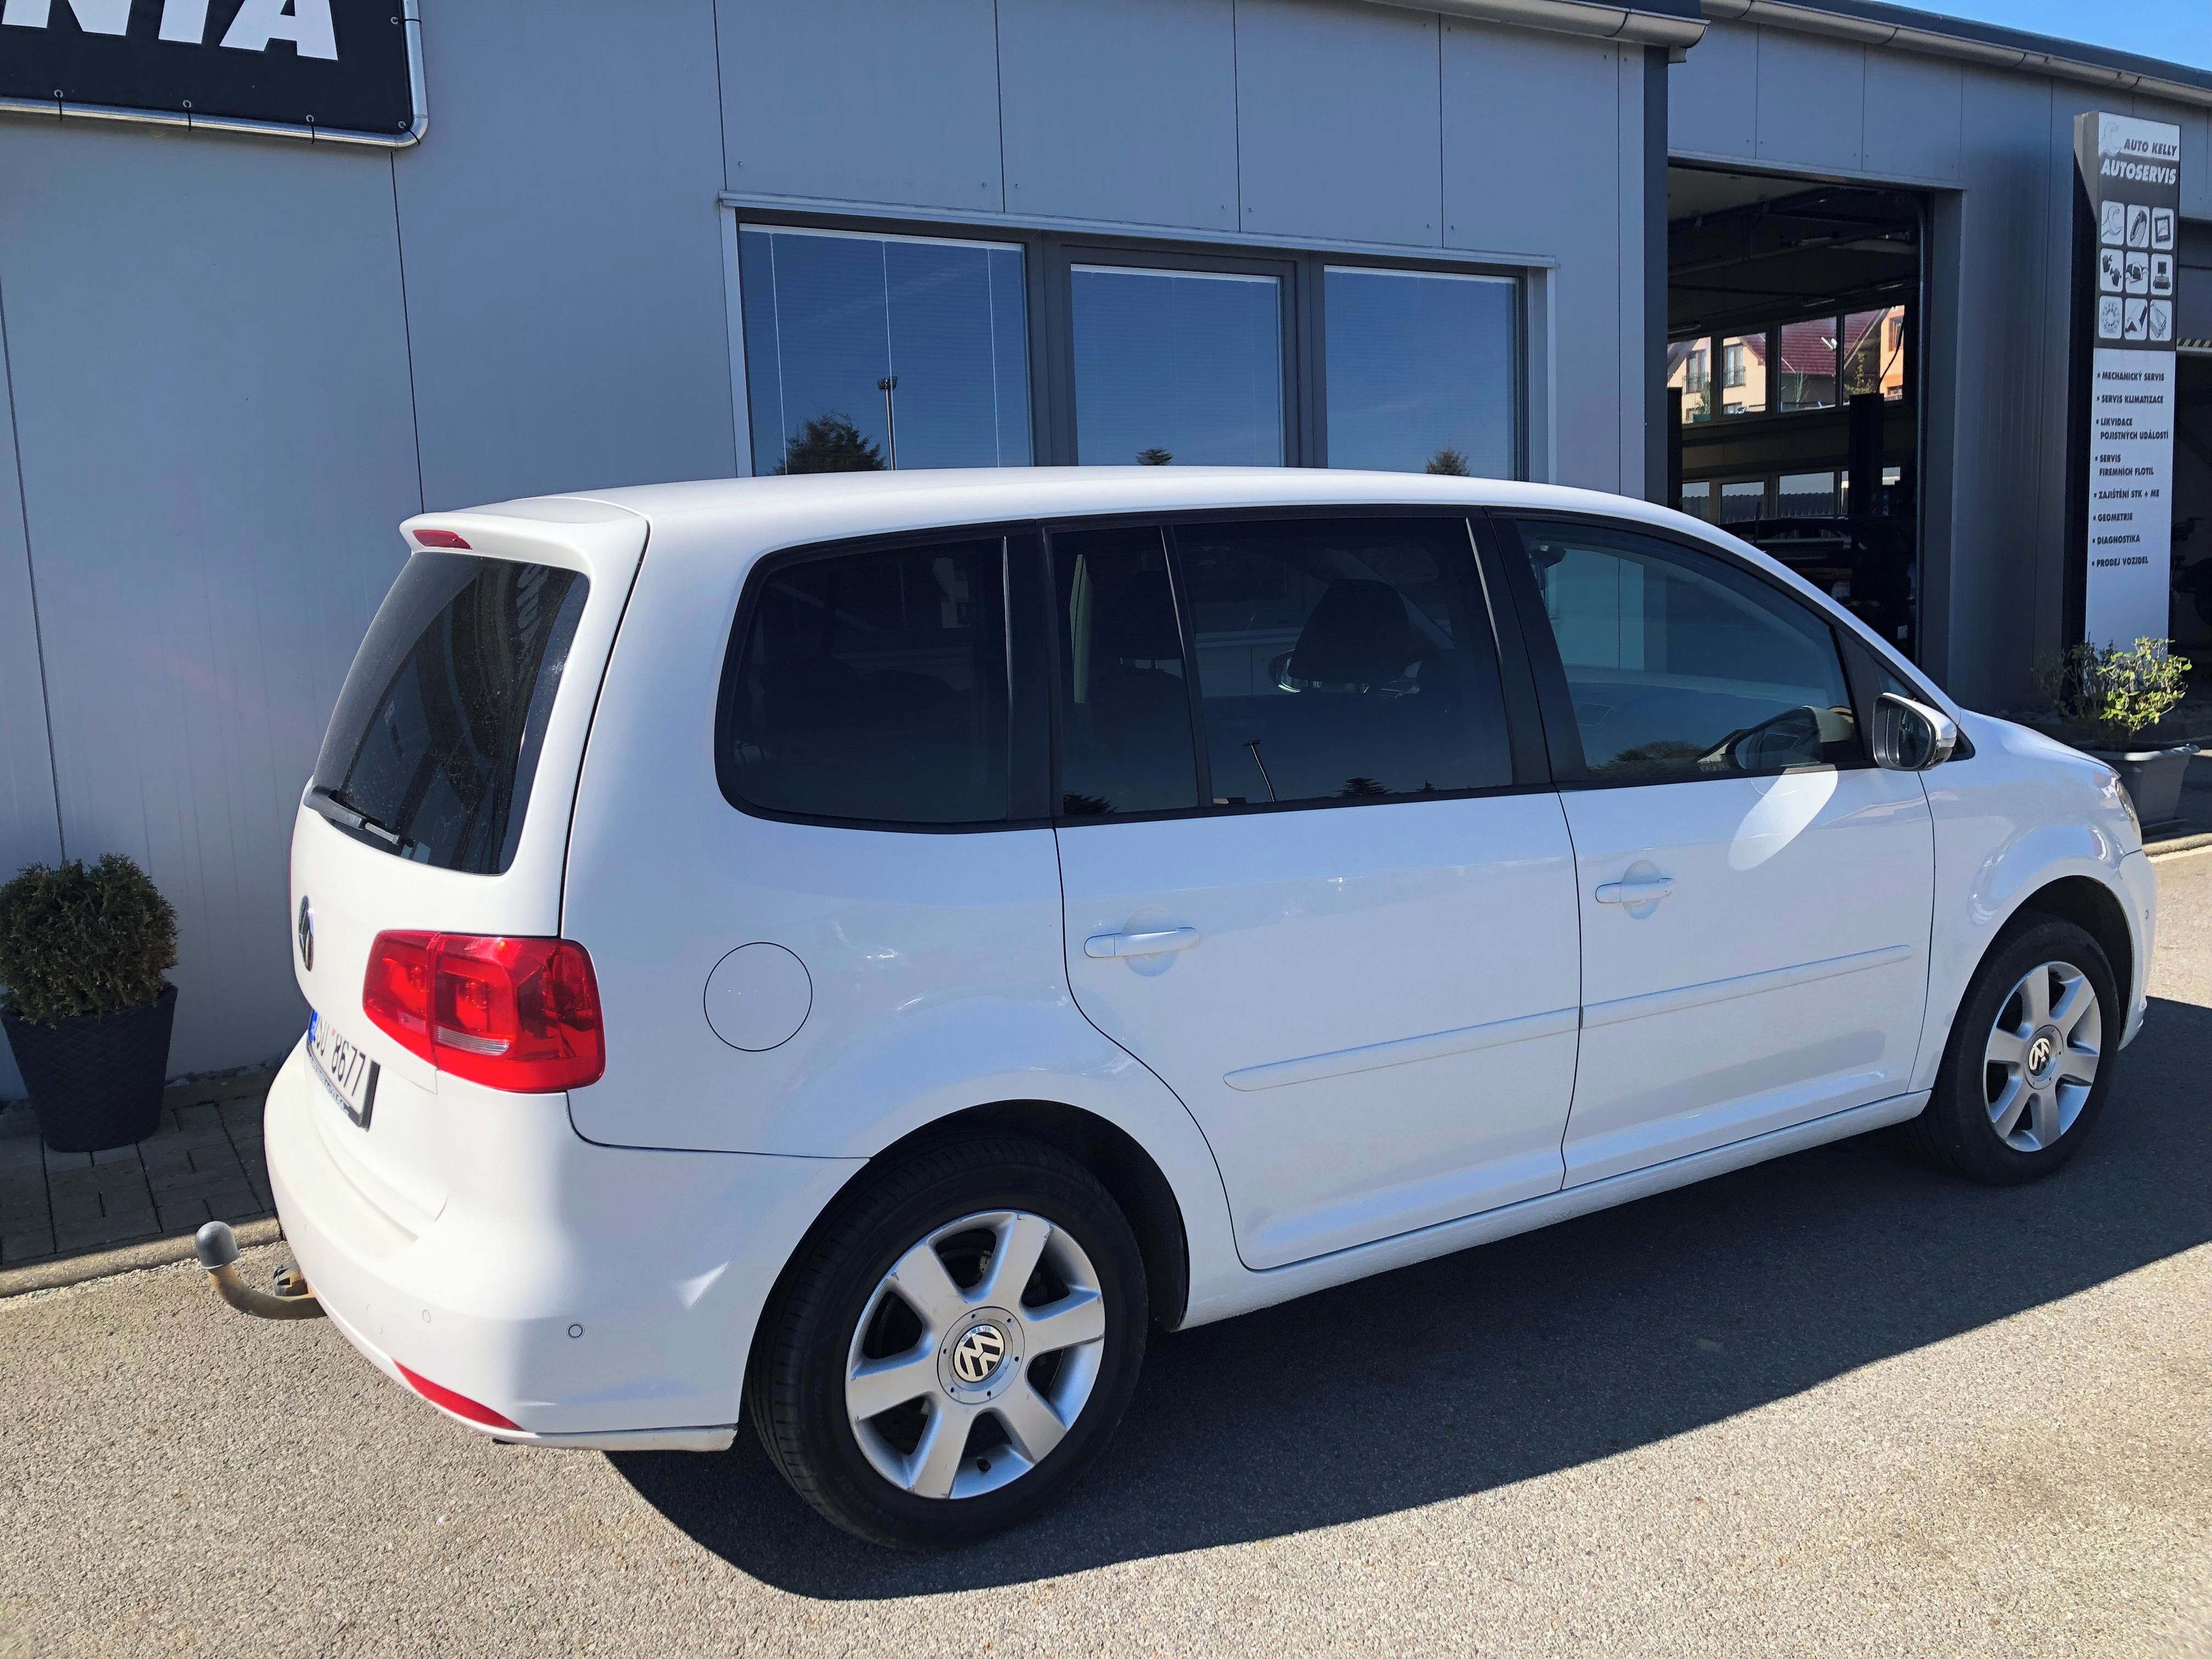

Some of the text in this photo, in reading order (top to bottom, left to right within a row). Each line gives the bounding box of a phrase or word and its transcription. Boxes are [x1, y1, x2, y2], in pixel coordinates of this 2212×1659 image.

[2124, 138, 2177, 156] AUTO KELLY
[2101, 159, 2176, 184] AUTOSERVIS
[2102, 371, 2164, 381] MECHANICKÝ SERVIS
[2101, 394, 2164, 404] SERVIS KLIMATIZACE
[2101, 417, 2132, 426] LIKVIDACE
[2100, 429, 2169, 439] POJISTNÝCH UDÁLOSTÍ
[2100, 454, 2121, 462] SERVIS
[2099, 466, 2154, 476] FIREMNÍCH FLOTIL
[2131, 490, 2142, 498] STK
[2151, 489, 2159, 497] ME
[2097, 512, 2133, 522] GEOMETRIE
[2097, 534, 2140, 545] DIAGNOSTIKA
[2096, 556, 2148, 567] PRODEJ VOZIDEL
[332, 1034, 365, 1096] 8677
